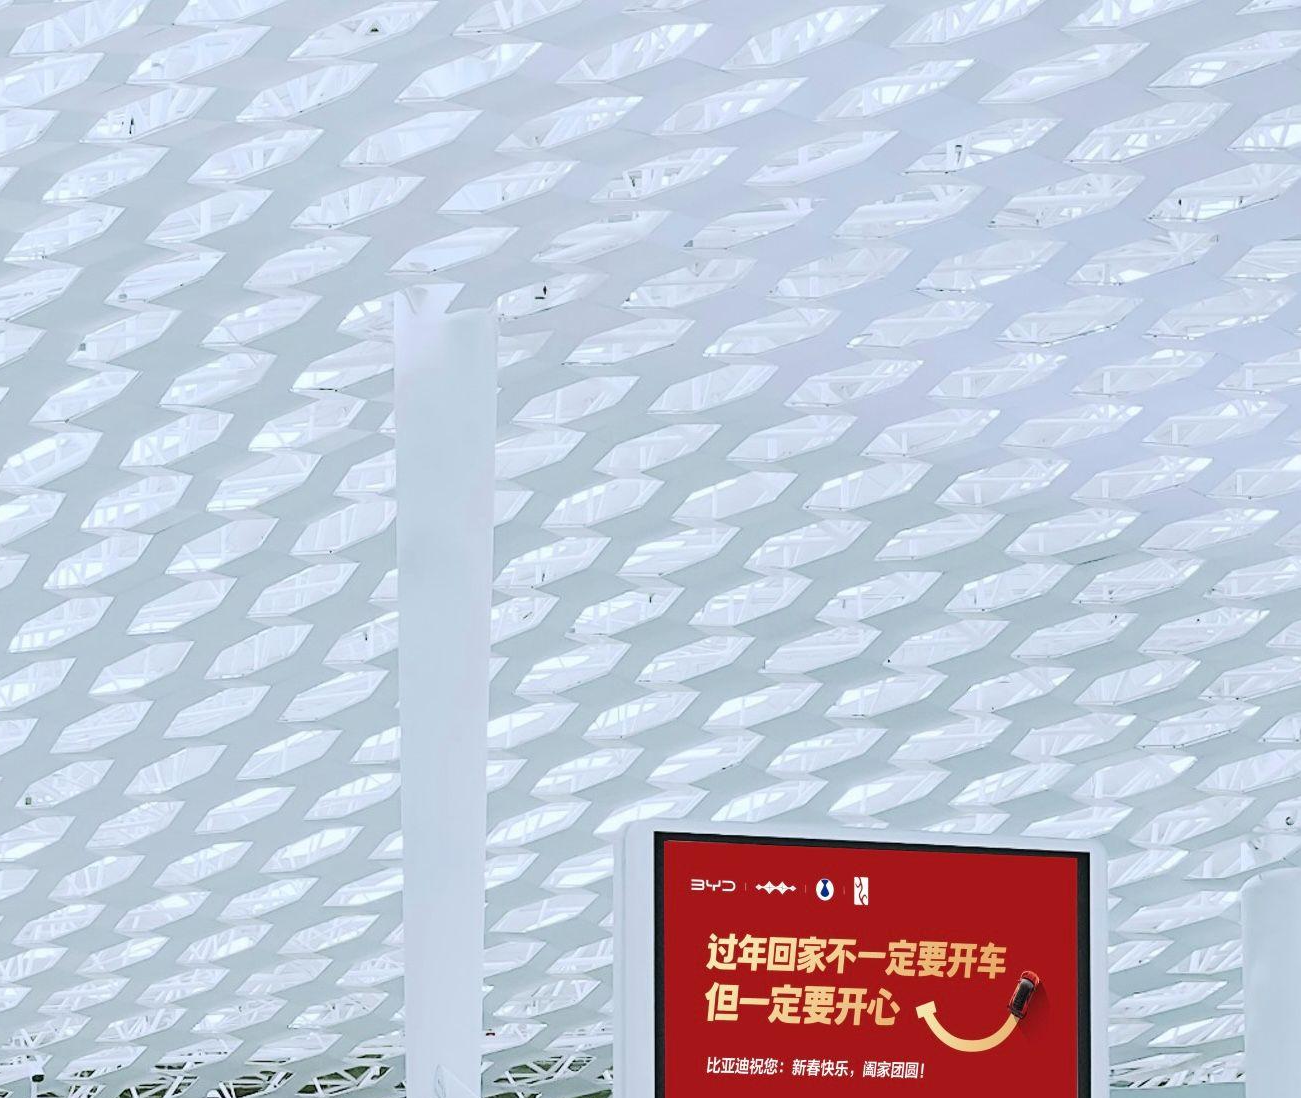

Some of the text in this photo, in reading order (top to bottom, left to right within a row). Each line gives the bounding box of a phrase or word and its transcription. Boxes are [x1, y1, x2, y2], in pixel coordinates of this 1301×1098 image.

[705, 932, 1007, 980] 过年回家不一定要开车
[704, 981, 901, 1026] 但一定要开心
